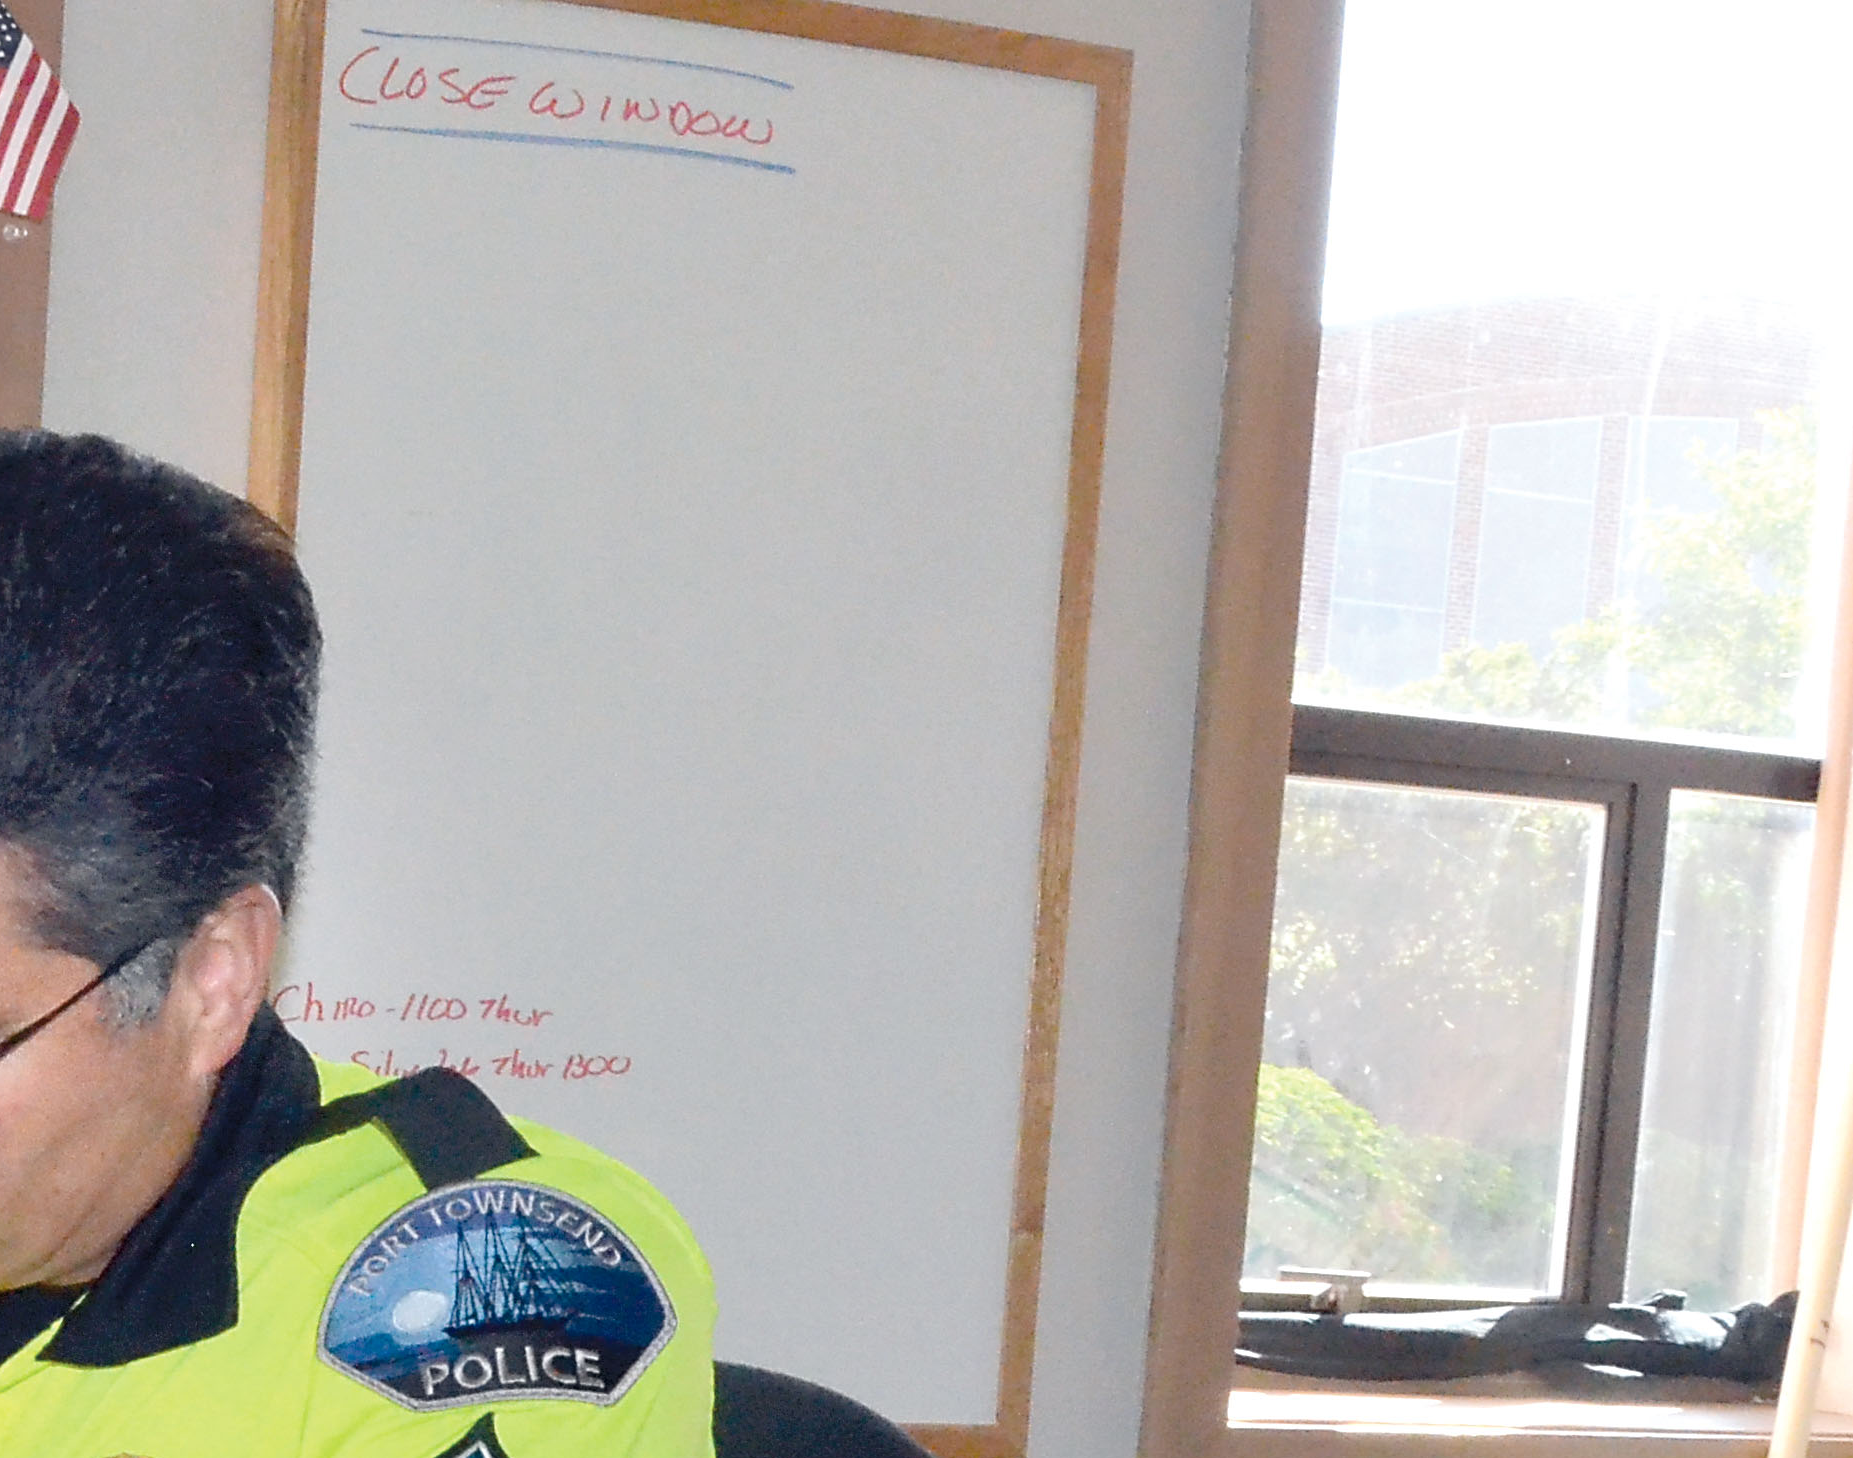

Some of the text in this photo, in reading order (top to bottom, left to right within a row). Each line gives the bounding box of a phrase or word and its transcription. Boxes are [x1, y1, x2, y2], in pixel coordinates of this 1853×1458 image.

[338, 45, 774, 146] CLOSE WINDOW
[348, 1188, 623, 1297] PORT TOWNSEND
[421, 1345, 607, 1396] POLICE
